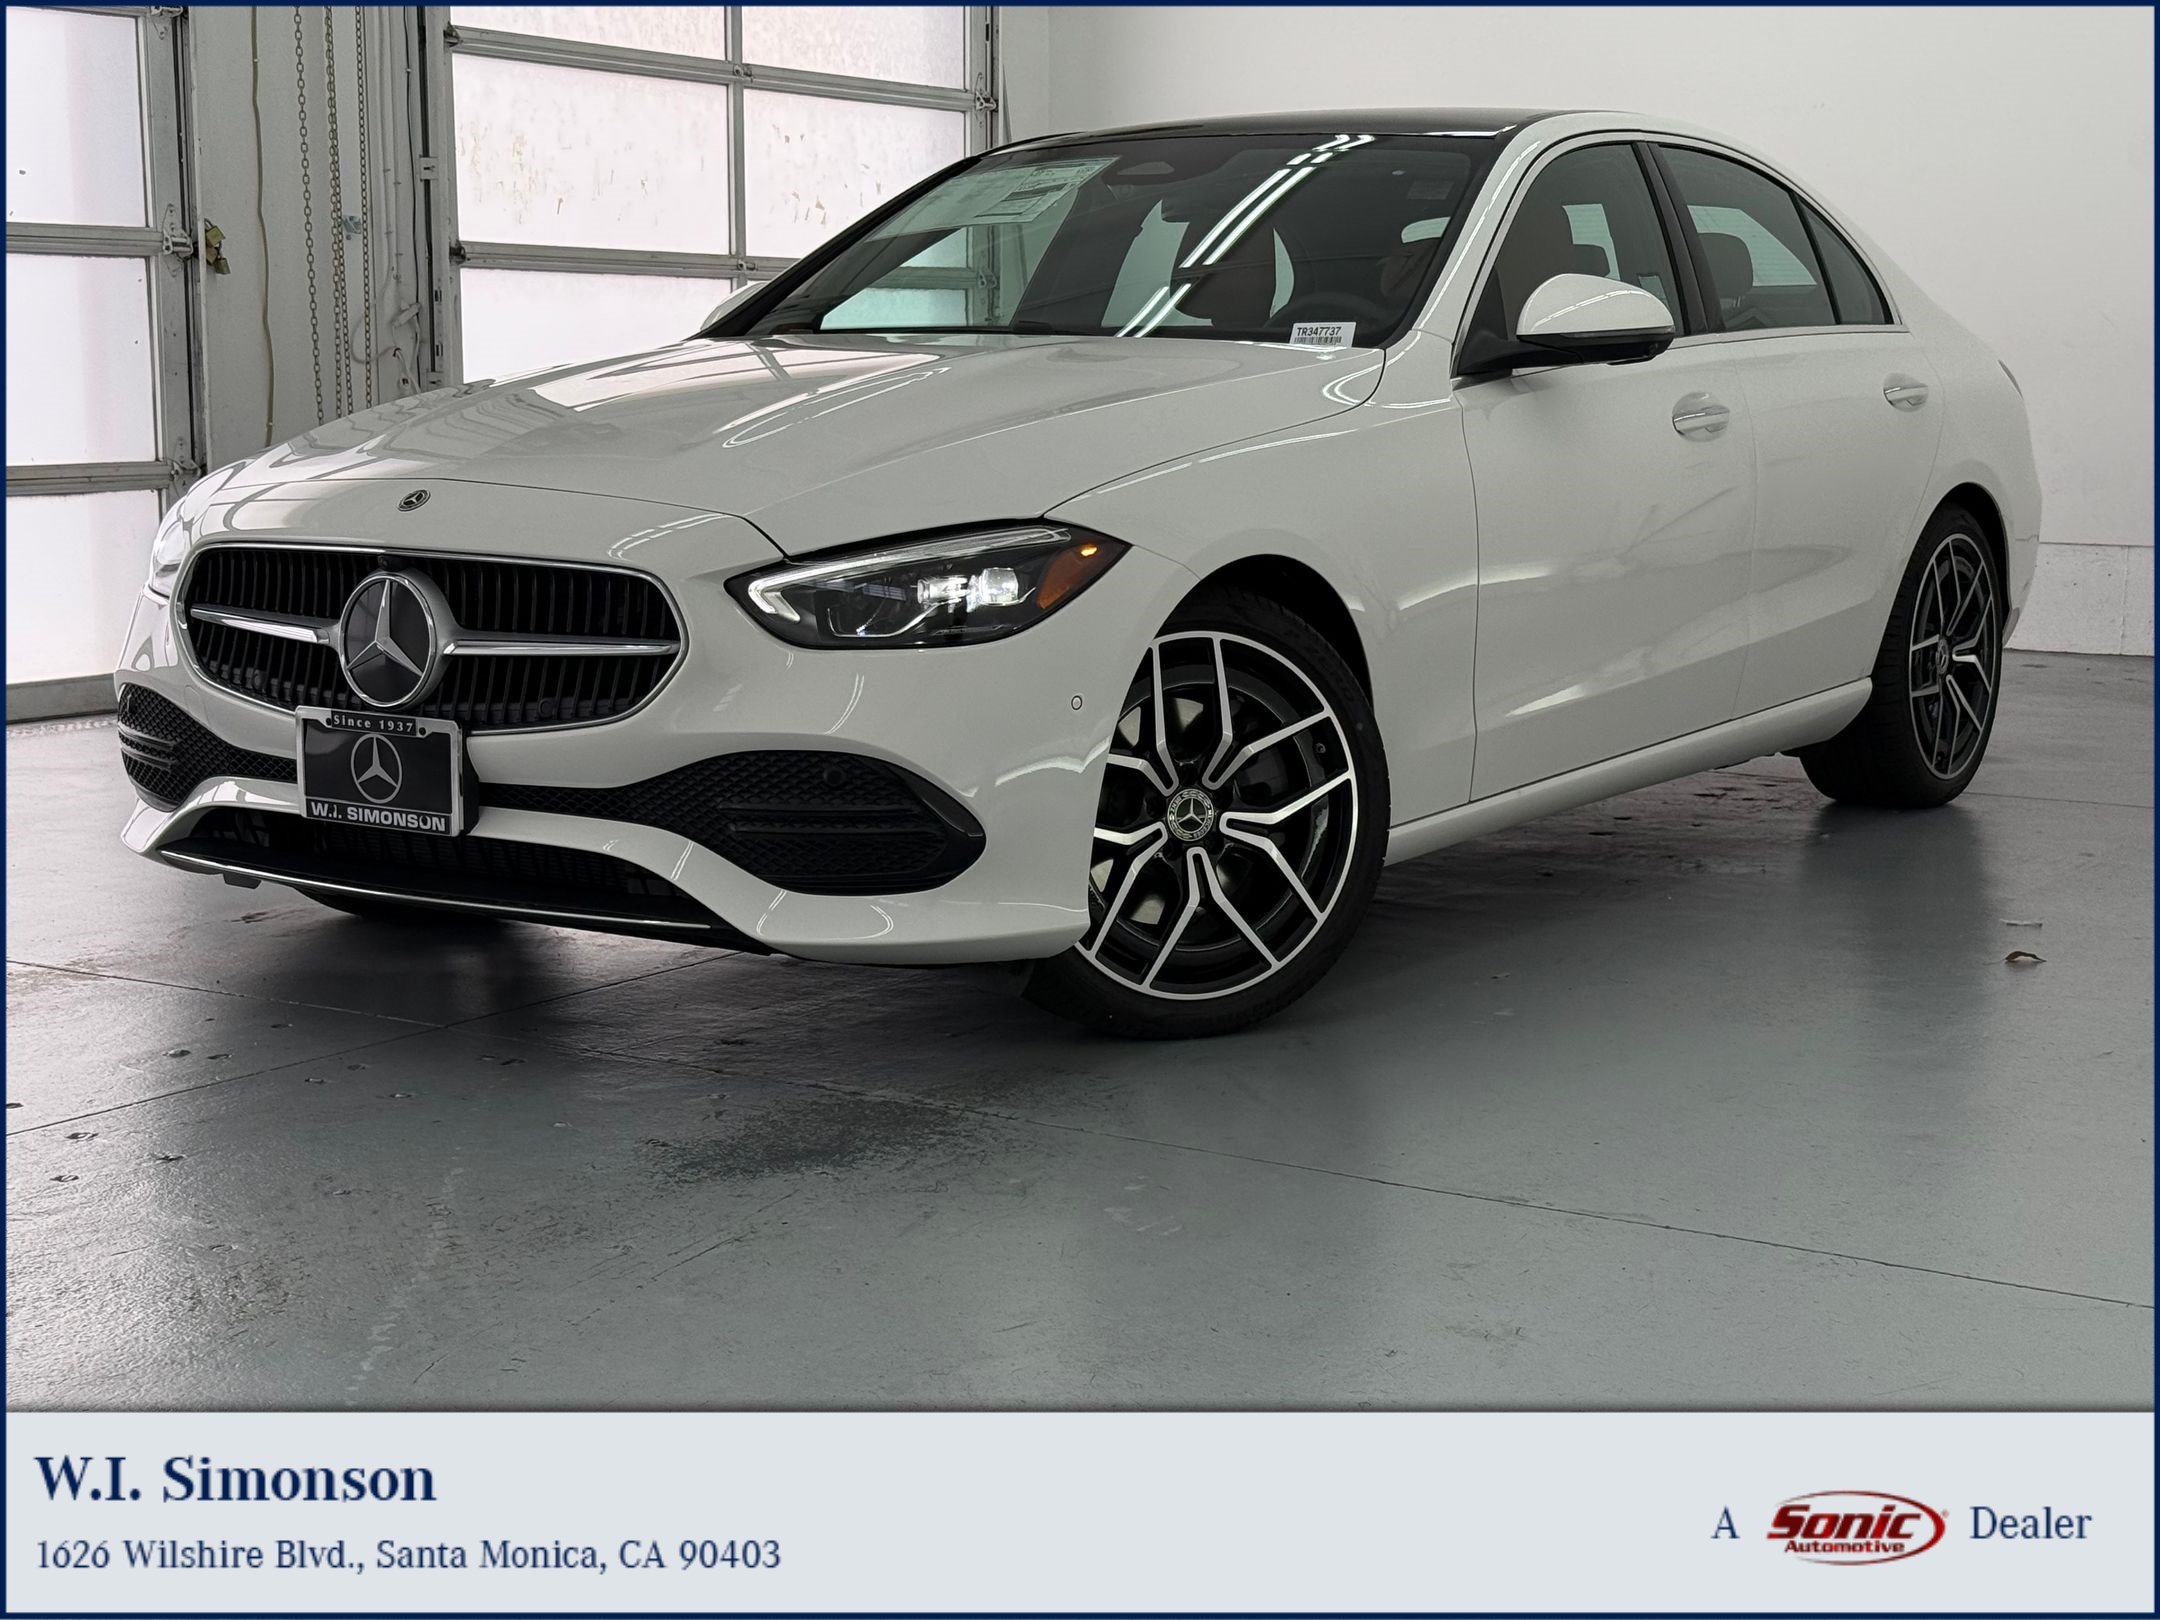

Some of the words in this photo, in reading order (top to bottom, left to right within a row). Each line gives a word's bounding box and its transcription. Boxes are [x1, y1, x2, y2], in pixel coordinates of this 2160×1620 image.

[1296, 326, 1342, 337] TR347737
[333, 715, 371, 728] Since
[379, 719, 414, 733] 1937
[347, 806, 446, 831] SIMONSON
